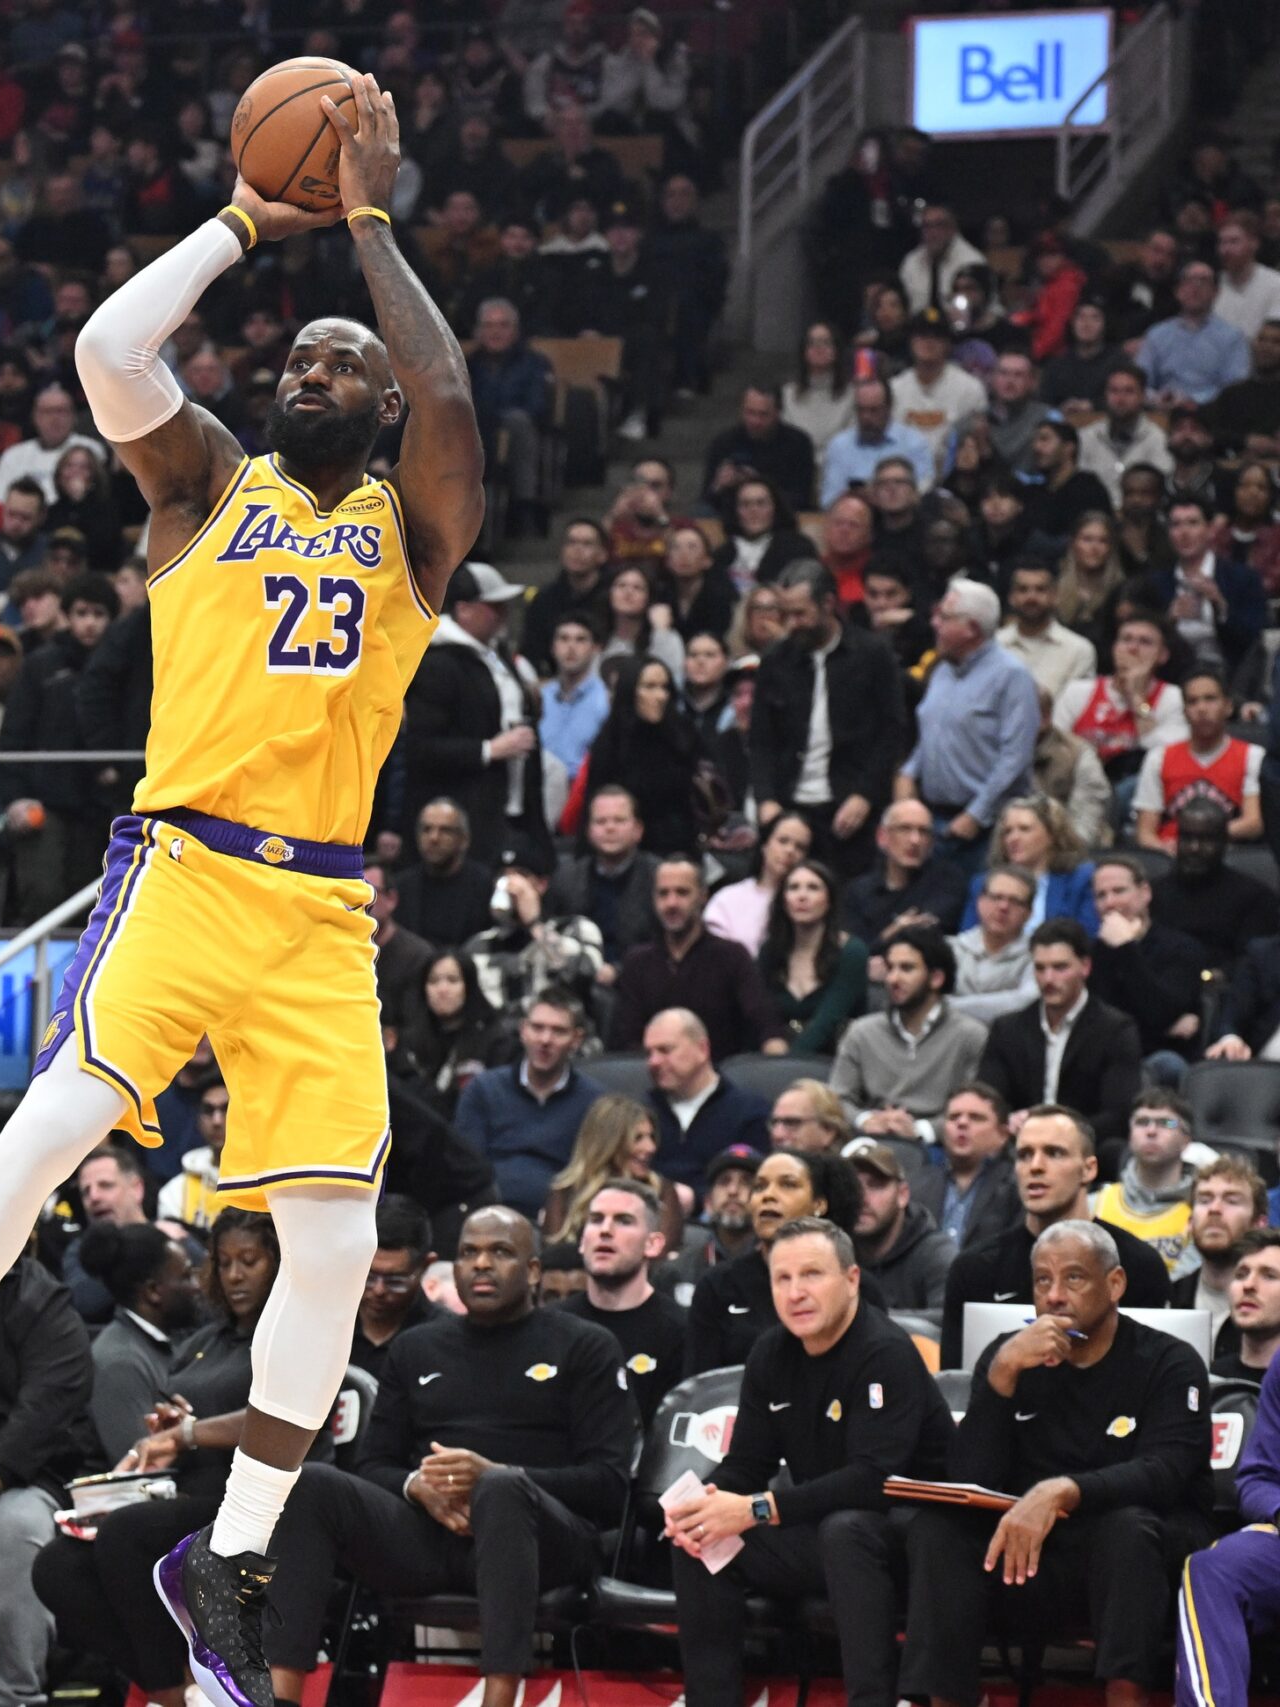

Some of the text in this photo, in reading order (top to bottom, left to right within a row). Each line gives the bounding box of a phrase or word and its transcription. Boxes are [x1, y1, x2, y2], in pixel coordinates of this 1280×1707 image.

[959, 42, 1062, 104] Bell
[215, 503, 382, 568] LAKERS
[340, 500, 382, 513] bibigo
[263, 574, 366, 677] 23
[257, 841, 291, 860] LAKERS
